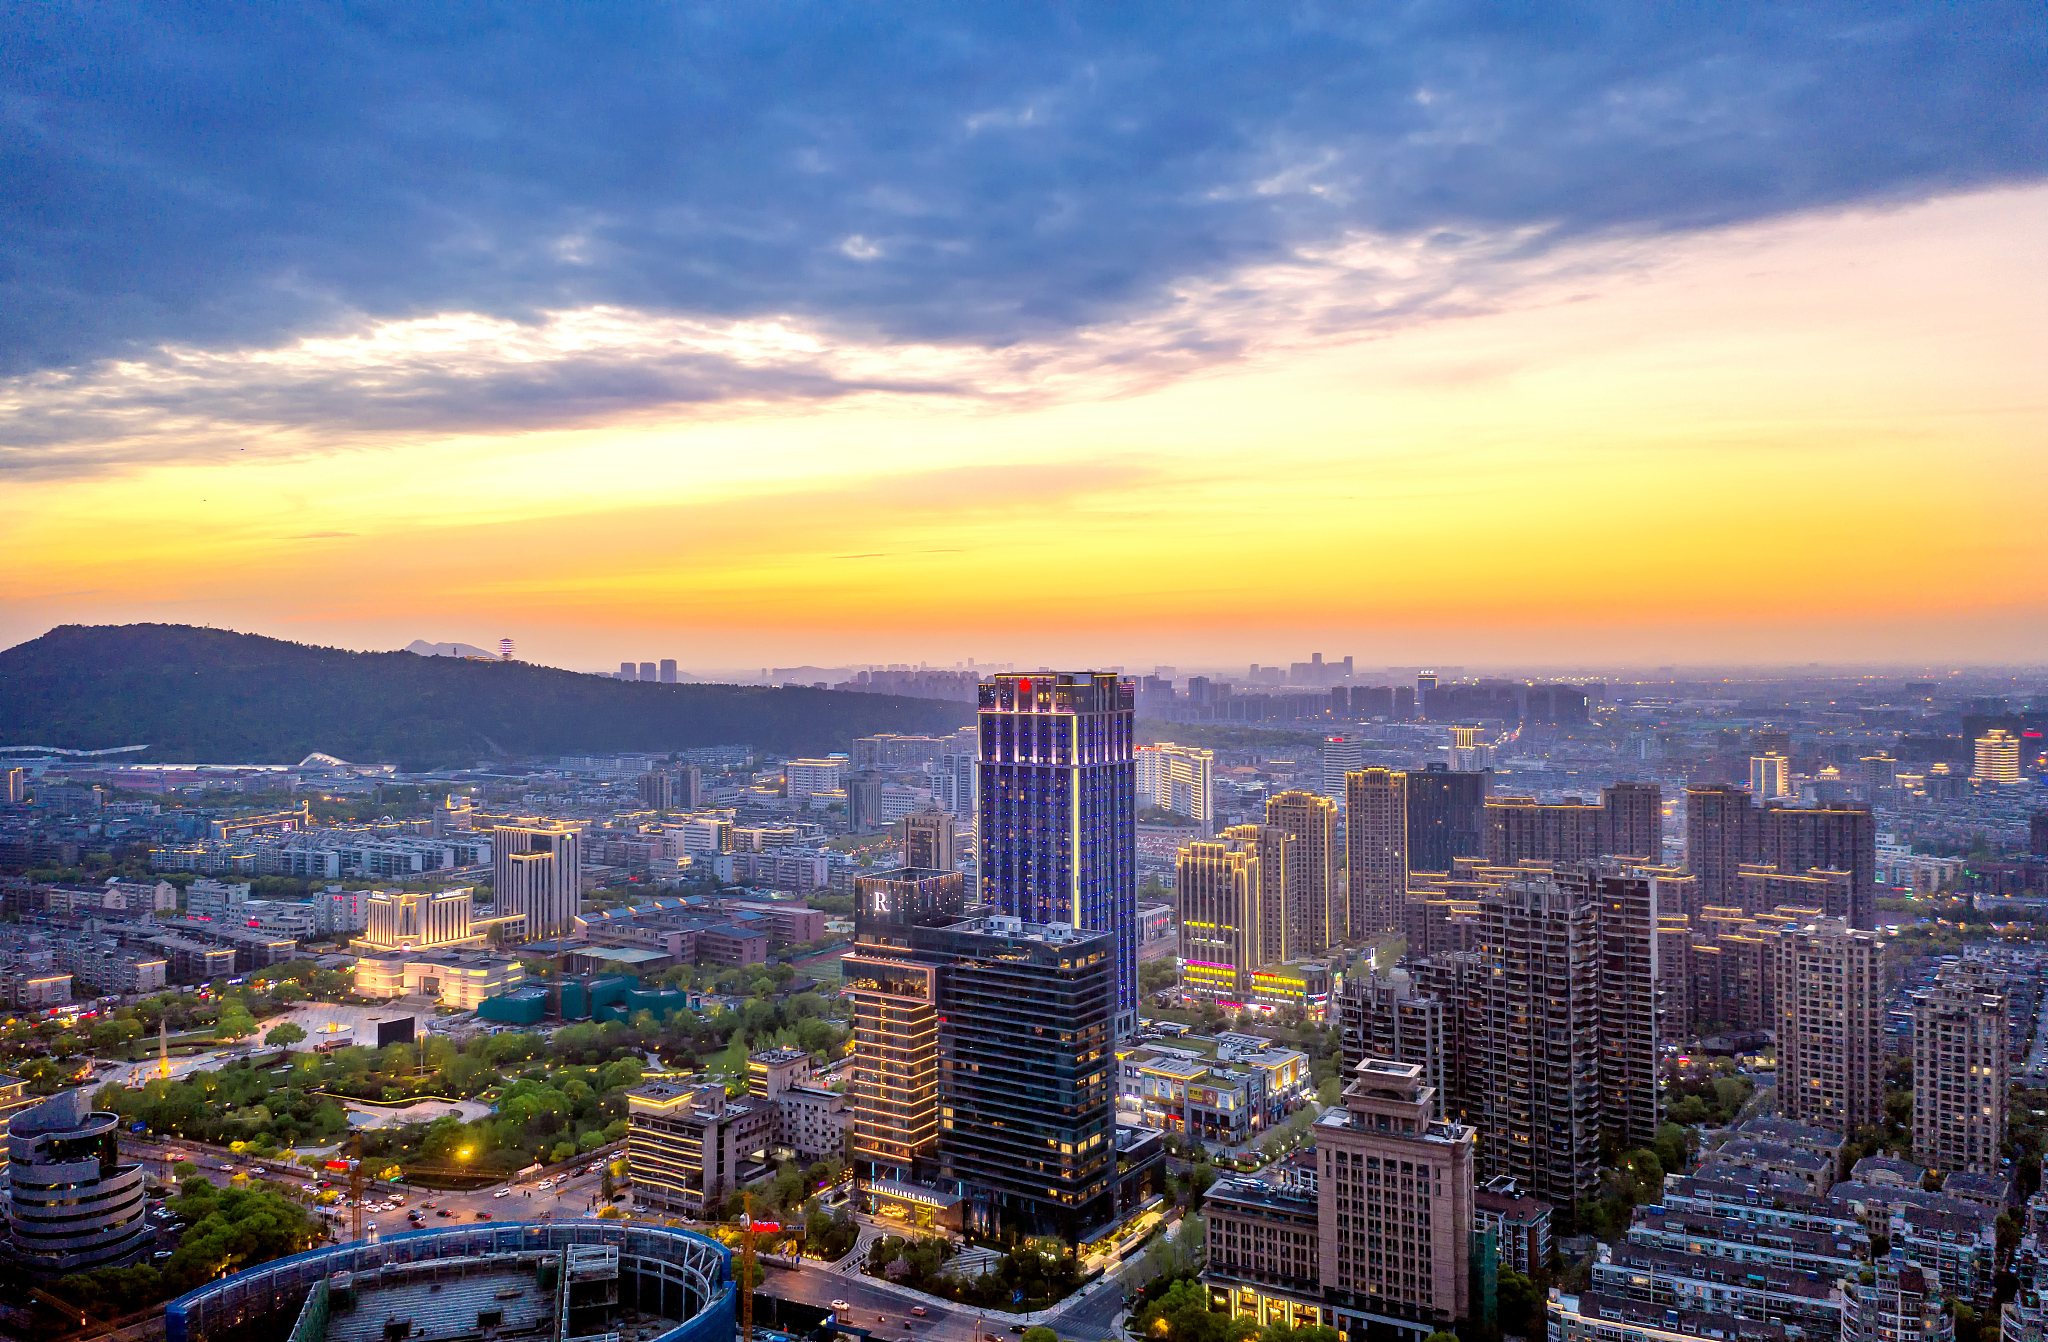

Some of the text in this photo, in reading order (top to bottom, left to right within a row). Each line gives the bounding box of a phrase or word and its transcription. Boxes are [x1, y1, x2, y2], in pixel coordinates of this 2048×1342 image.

[874, 891, 891, 911] R
[871, 1183, 938, 1205] RENAISSANCE HOTEL
